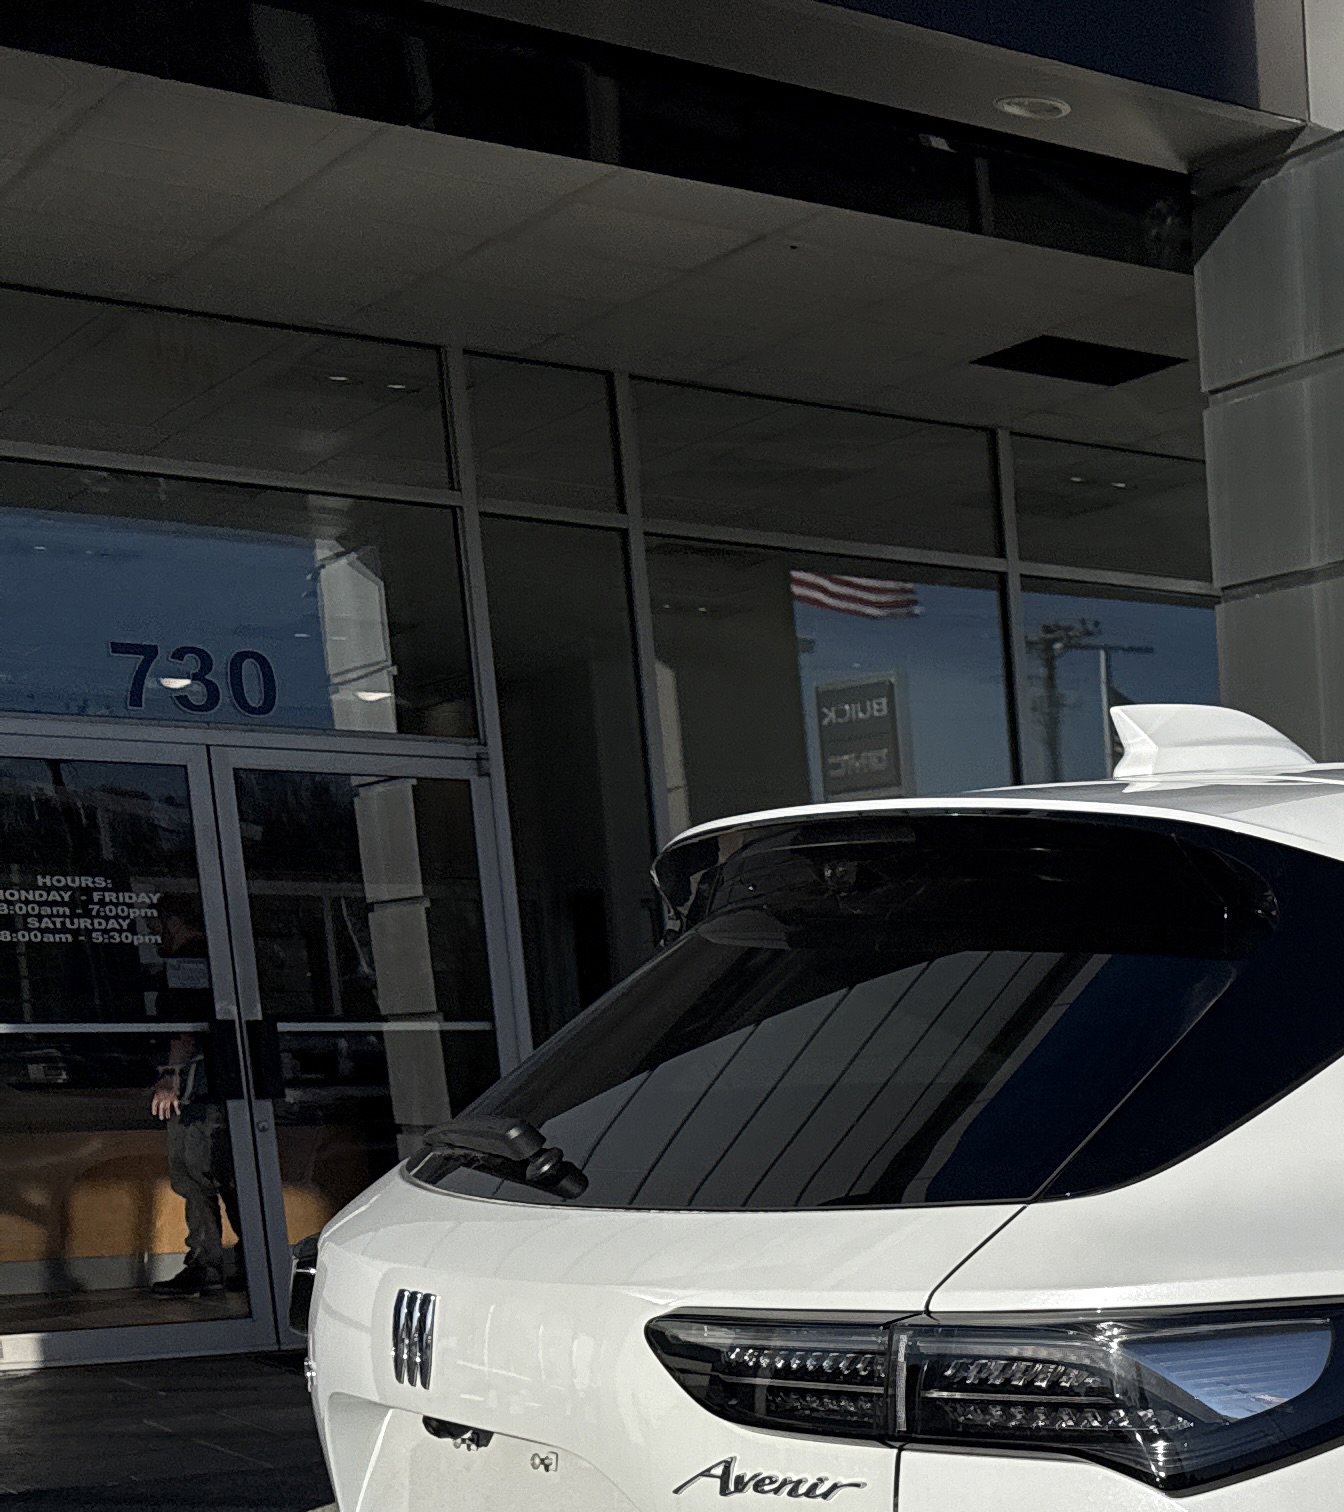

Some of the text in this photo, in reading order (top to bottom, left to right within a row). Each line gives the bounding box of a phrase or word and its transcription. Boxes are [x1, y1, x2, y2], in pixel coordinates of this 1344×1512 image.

[109, 641, 278, 716] 730
[37, 875, 113, 888] HOURS:
[0, 890, 73, 902] ONDAY
[92, 891, 161, 904] FRIDAY
[88, 904, 158, 919] 7:00pm
[26, 917, 131, 930] SATURDAY
[0, 930, 73, 943] 8:00am
[91, 932, 162, 946] 5:30pm
[672, 1455, 868, 1501] Avenir
